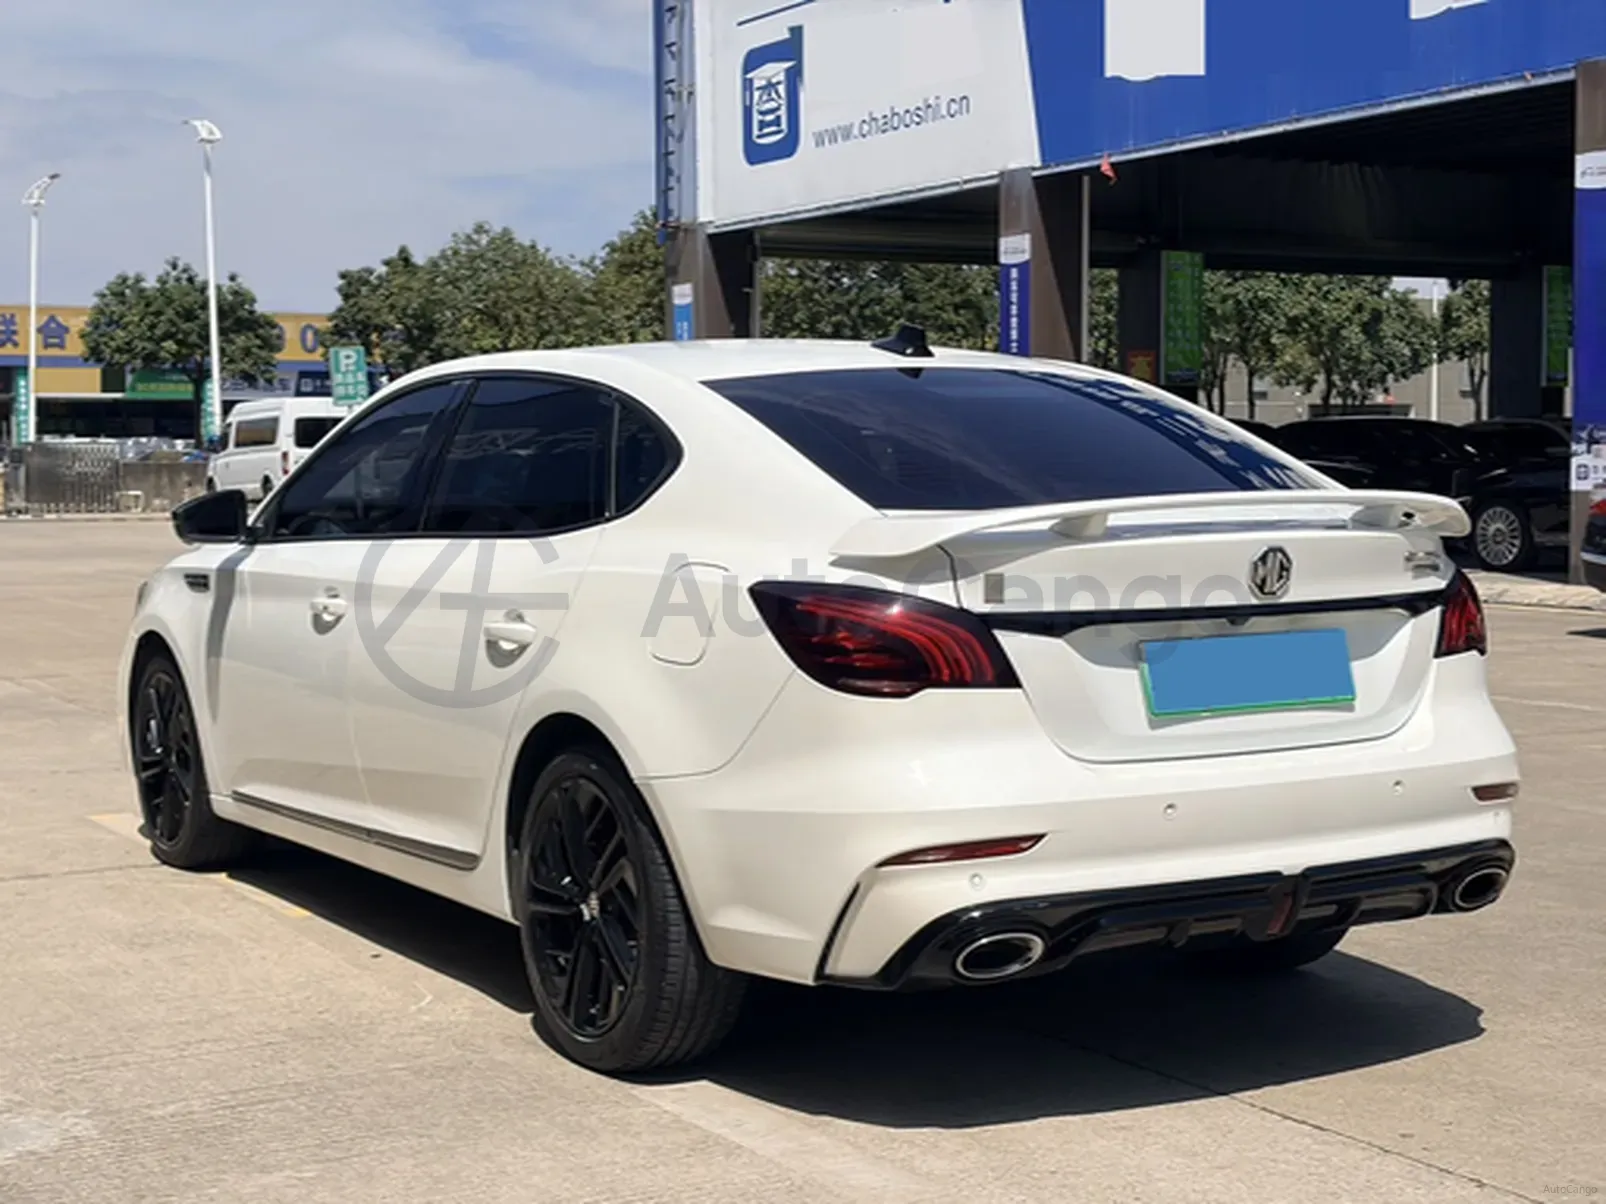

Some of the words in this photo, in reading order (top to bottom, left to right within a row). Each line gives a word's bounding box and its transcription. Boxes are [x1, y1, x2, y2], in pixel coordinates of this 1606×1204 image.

[812, 94, 971, 148] www.chaboshi.cn
[340, 351, 357, 372] P
[1251, 548, 1292, 598] MG
